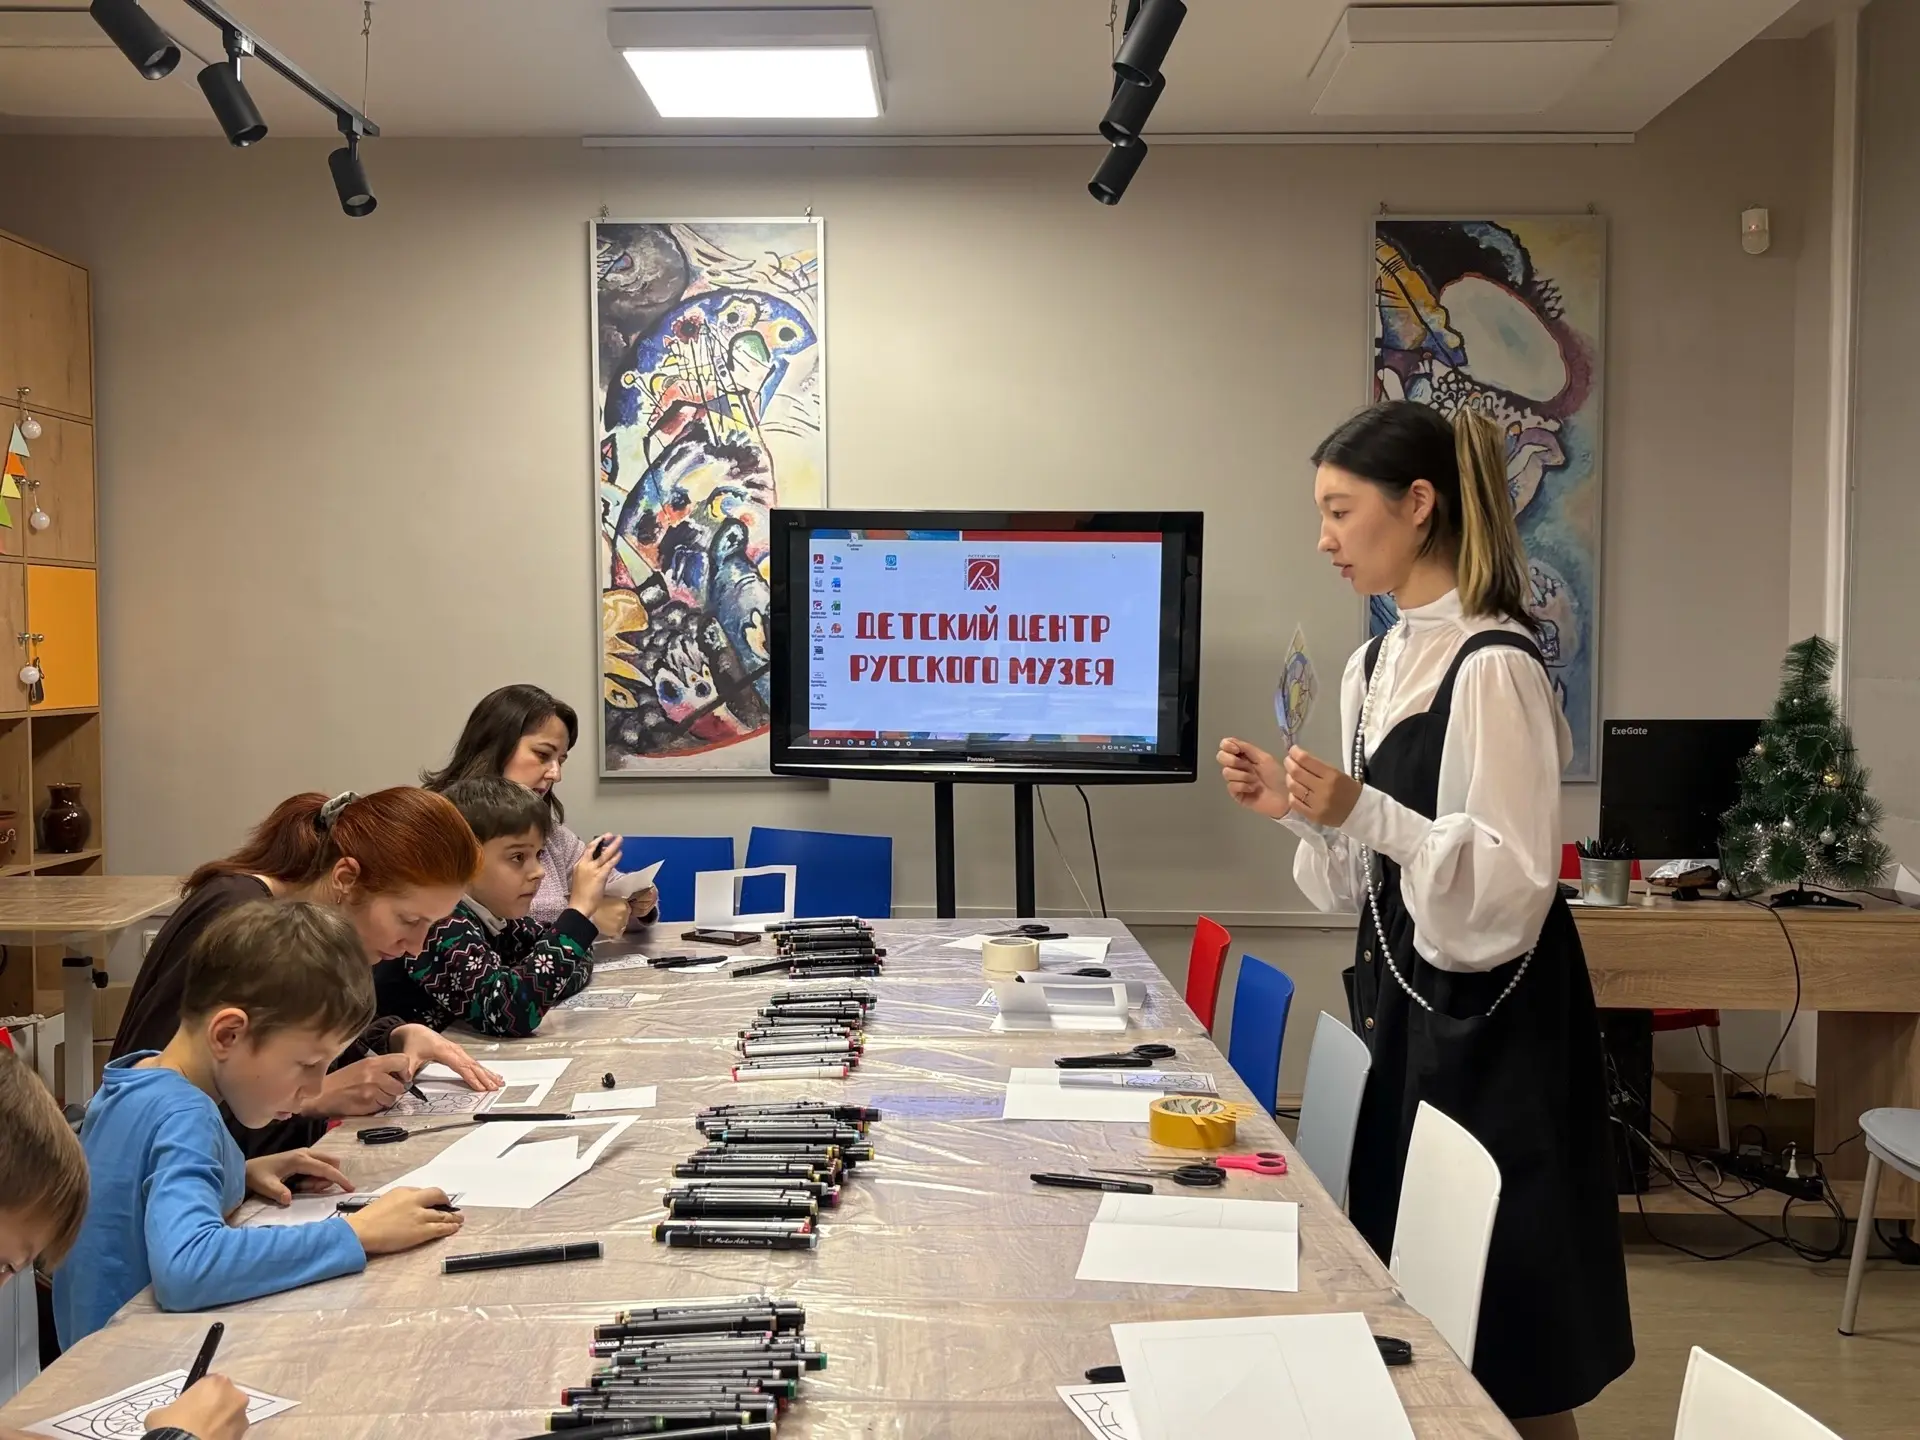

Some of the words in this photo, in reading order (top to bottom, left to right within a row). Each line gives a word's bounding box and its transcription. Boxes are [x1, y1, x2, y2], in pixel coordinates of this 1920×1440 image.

[855, 604, 999, 641] ДЕТСКИЙ
[1008, 614, 1111, 643] ЦЕНТР
[850, 654, 999, 684] РУССКОГО
[1009, 657, 1115, 686] МУЗЕЯ
[1611, 726, 1648, 736] ExeGate
